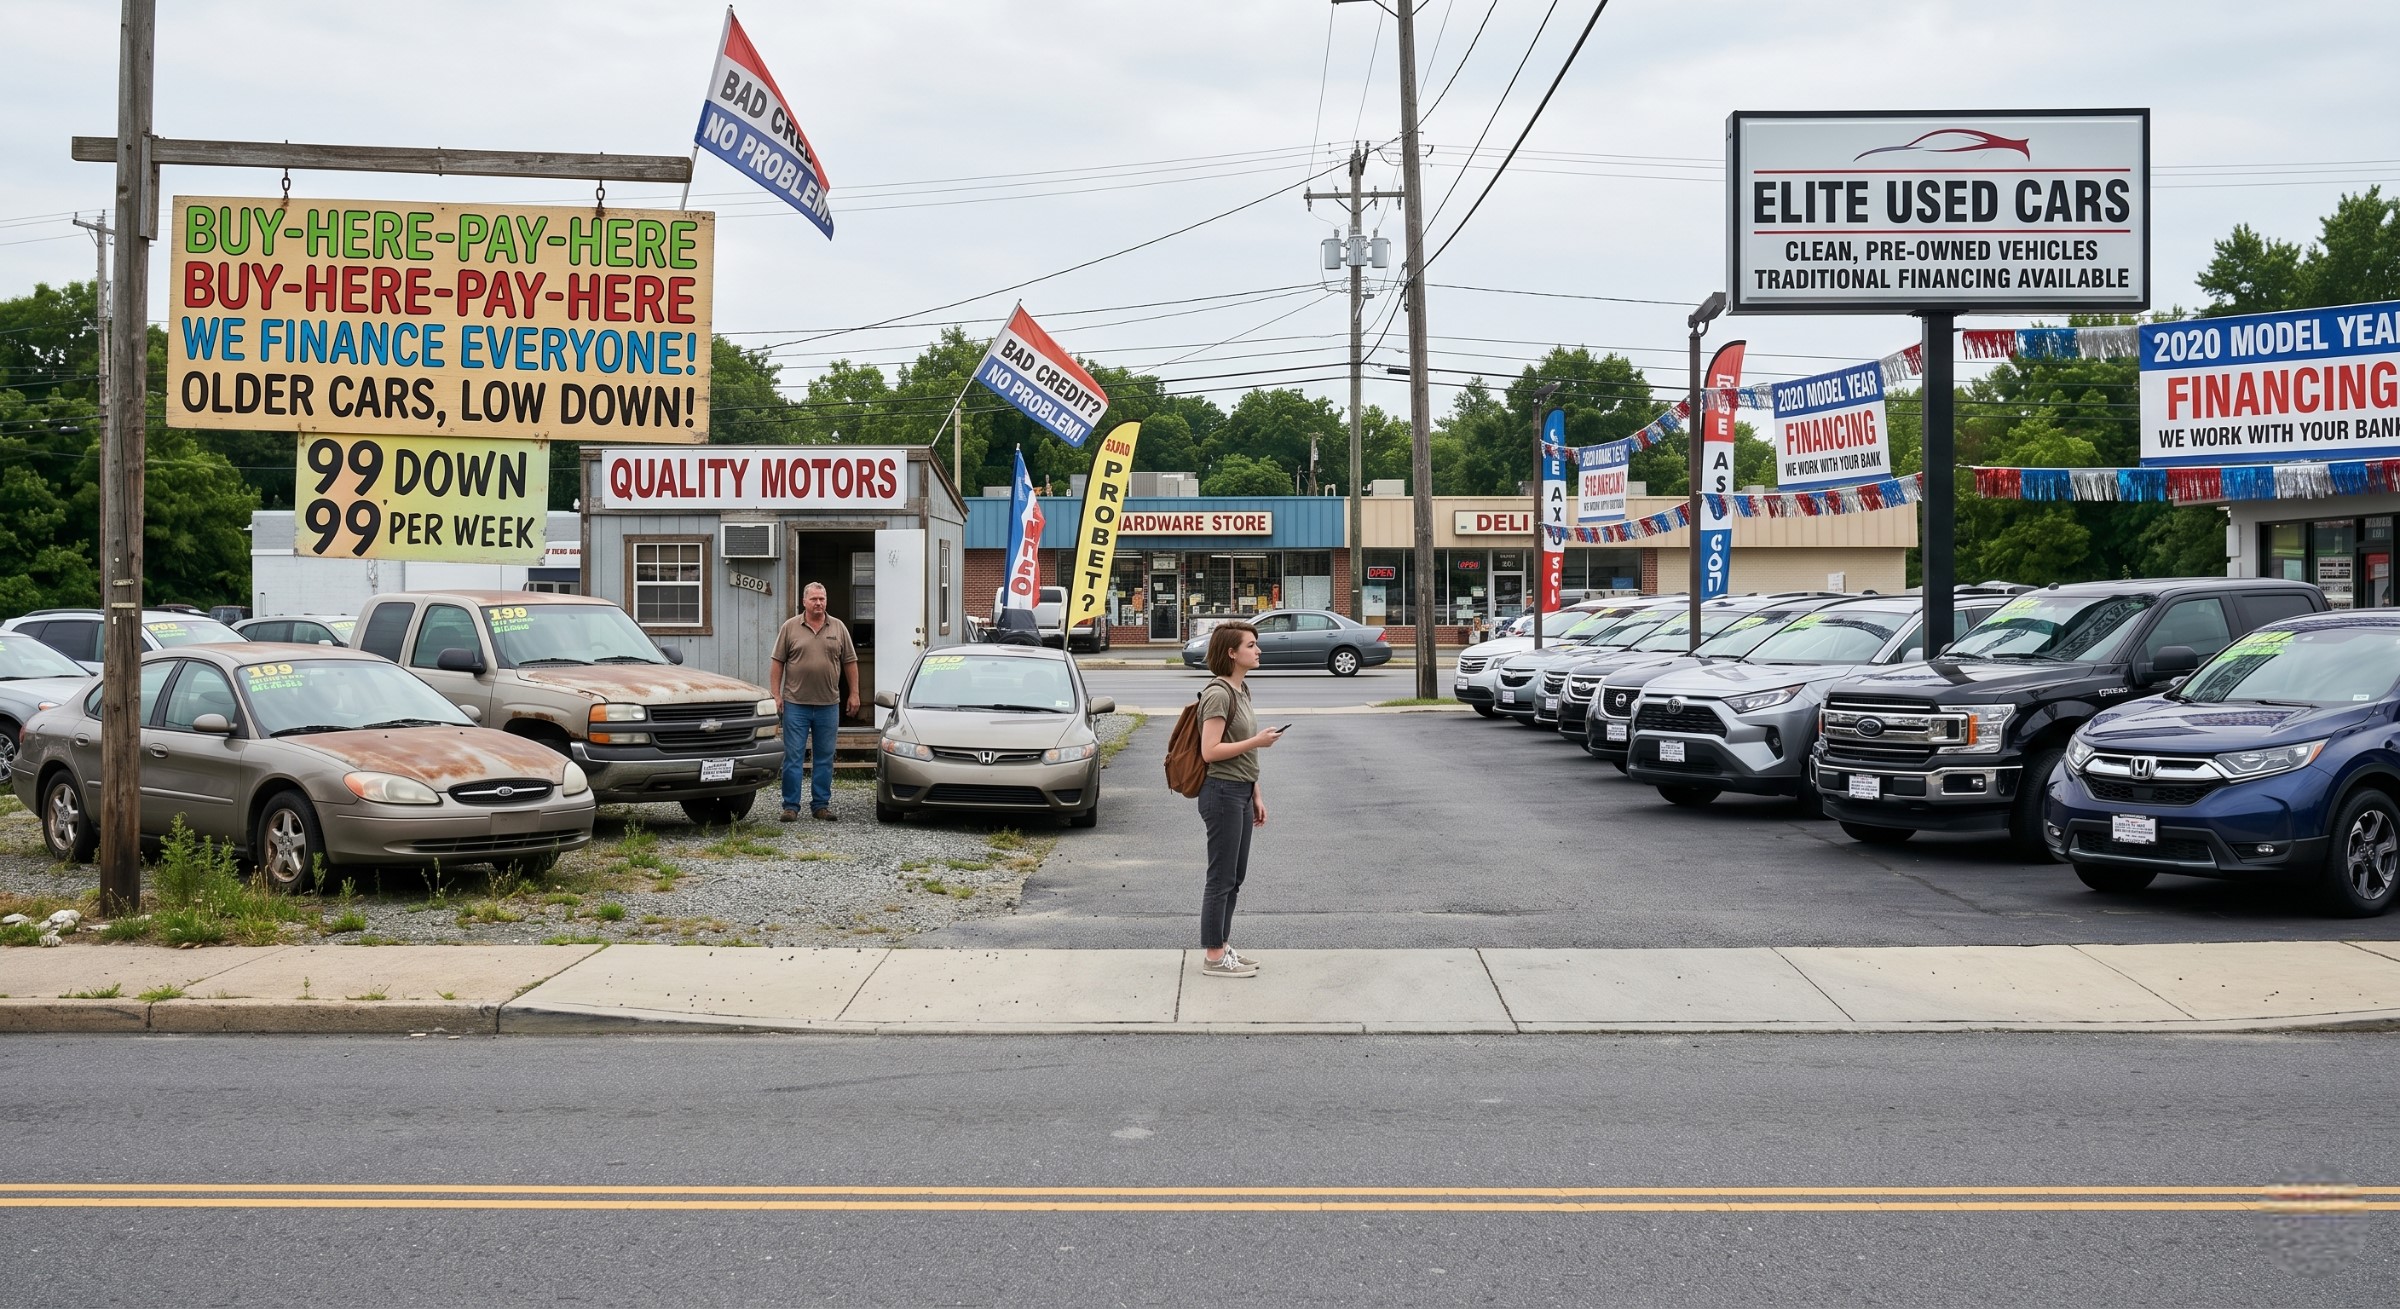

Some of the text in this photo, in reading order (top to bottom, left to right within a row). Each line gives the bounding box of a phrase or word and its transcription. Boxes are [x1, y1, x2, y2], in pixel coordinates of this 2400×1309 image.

[719, 69, 767, 118] BAD
[703, 112, 738, 151] NO
[1754, 178, 2130, 224] ELITE USED CARS
[185, 204, 698, 270] BUY-HERE-PAY-HERE
[1785, 239, 2098, 263] CLEAN, PRE-OWNED VEHICLES
[184, 260, 696, 324] BUY-HERE-PAY-HERE
[1754, 267, 2129, 290] TRADITIONAL FINANCING AVAILABLE
[181, 315, 697, 376] WE FINANCE EVERYONE!
[2153, 311, 2400, 363] 2020 MODEL YEA
[181, 370, 695, 428] OLDER CARS, LOW DOWN!
[1000, 338, 1102, 418] BAD CREDIT?
[1777, 370, 1878, 412] 2020 MODEL YEAR
[2168, 361, 2399, 420] FINANCING
[985, 363, 1086, 443] NO PROBLEM!
[1785, 409, 1877, 456] FINANCING
[2158, 429, 2185, 448] WE
[2190, 426, 2242, 447] WORK
[2247, 423, 2293, 444] WITH
[2299, 420, 2349, 442] YOUR
[307, 438, 527, 500] 99 DOWN
[610, 458, 897, 501] QUALITY MOTORS
[1785, 451, 1881, 477] WE WORK WITH YOUR BANK
[305, 498, 535, 557] 99 PER WEEK
[1212, 515, 1266, 531] STORE
[1476, 514, 1529, 531] DELI
[1368, 568, 1394, 578] OPEN
